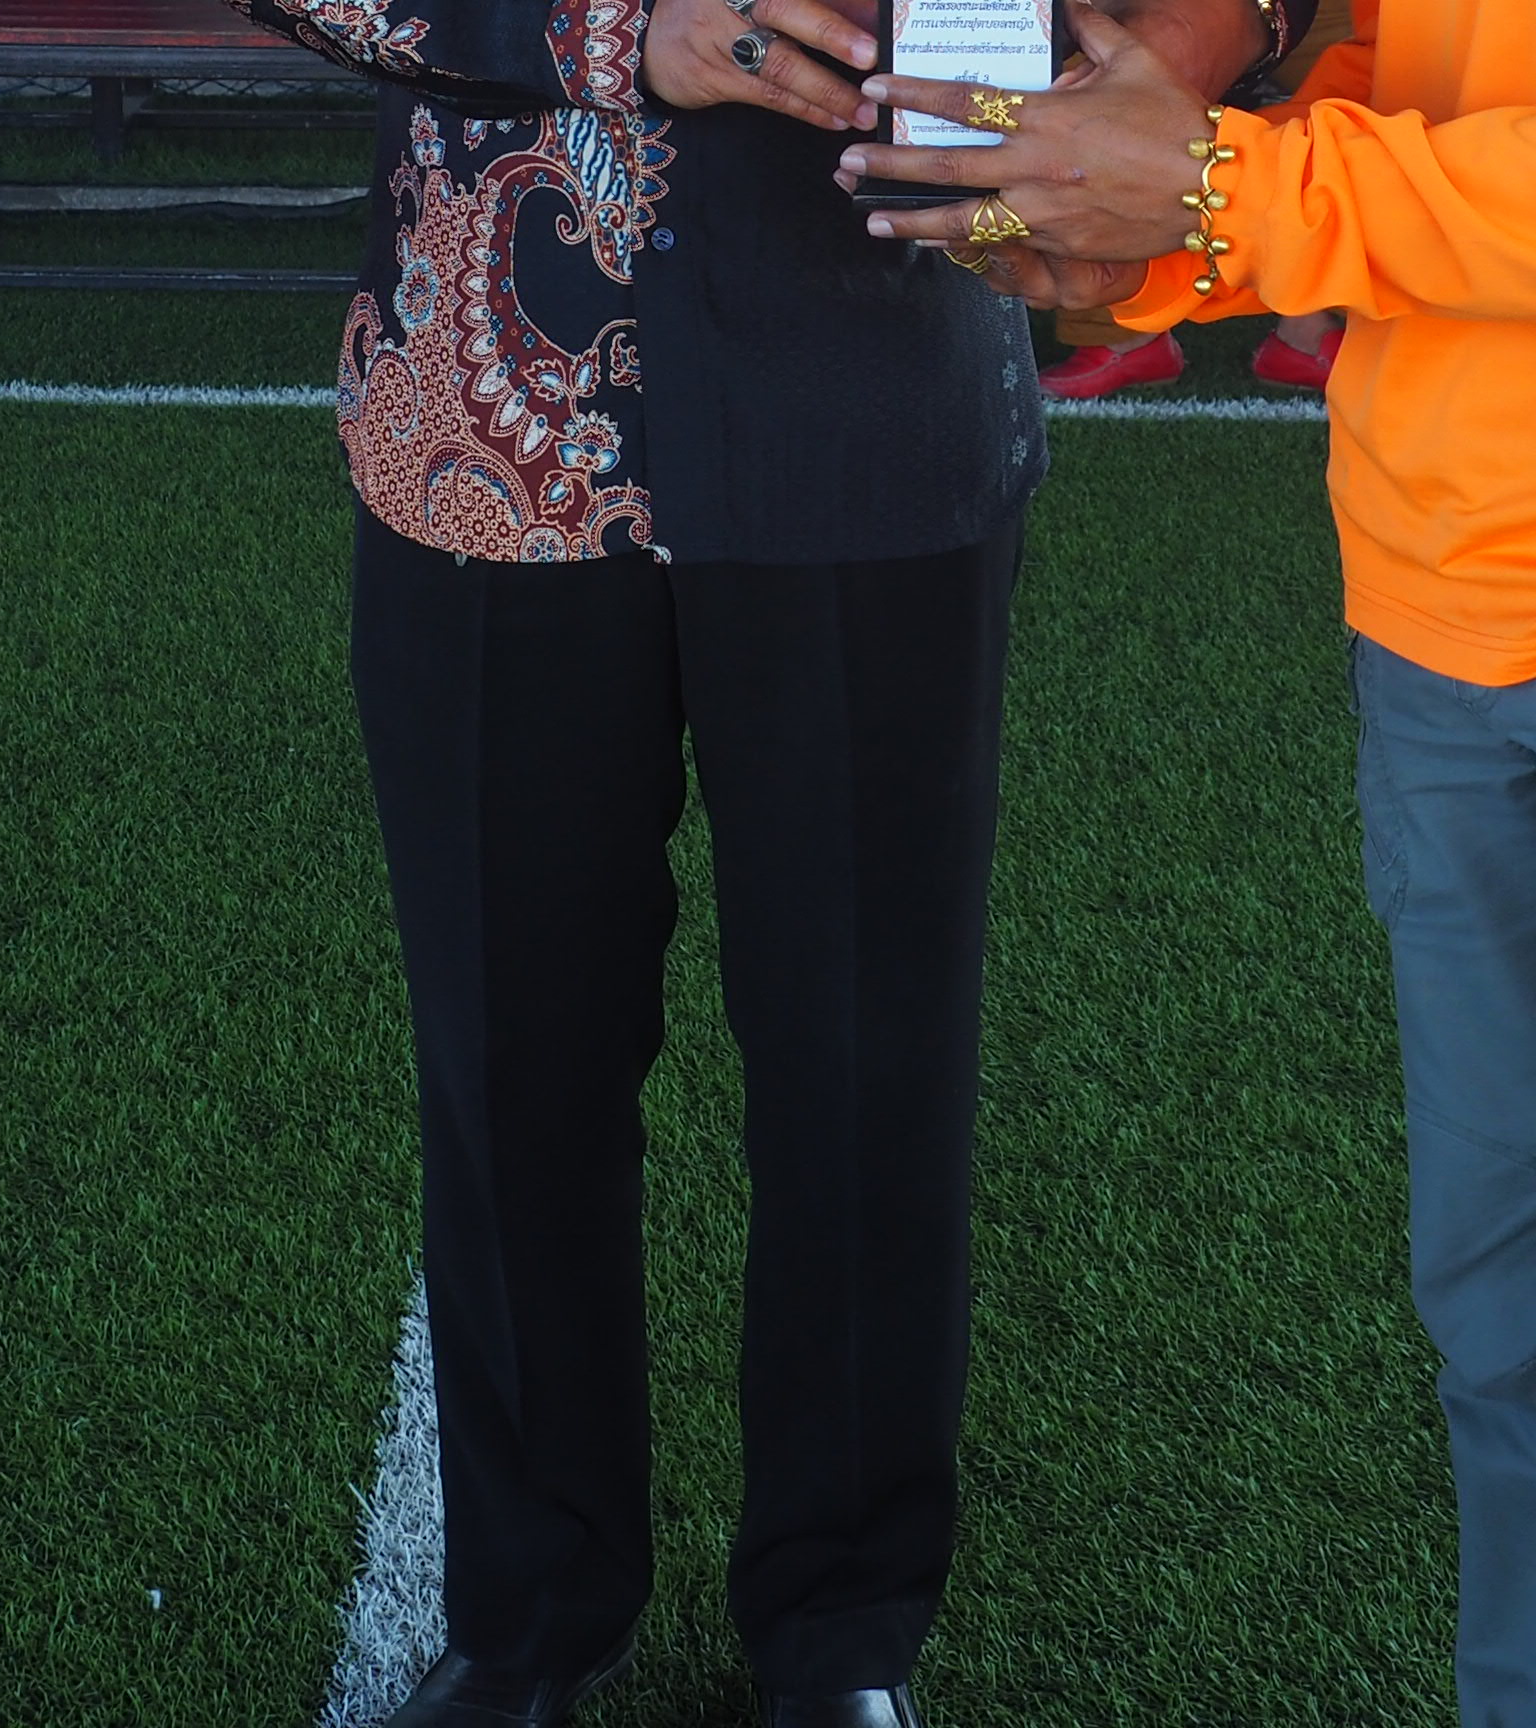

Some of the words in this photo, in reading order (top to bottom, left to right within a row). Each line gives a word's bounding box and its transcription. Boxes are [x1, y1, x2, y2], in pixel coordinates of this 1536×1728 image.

[1024, 1, 1032, 11] 2
[910, 16, 1035, 33] การแข่งขันฟุตบอลหญิง
[982, 73, 990, 83] 3
